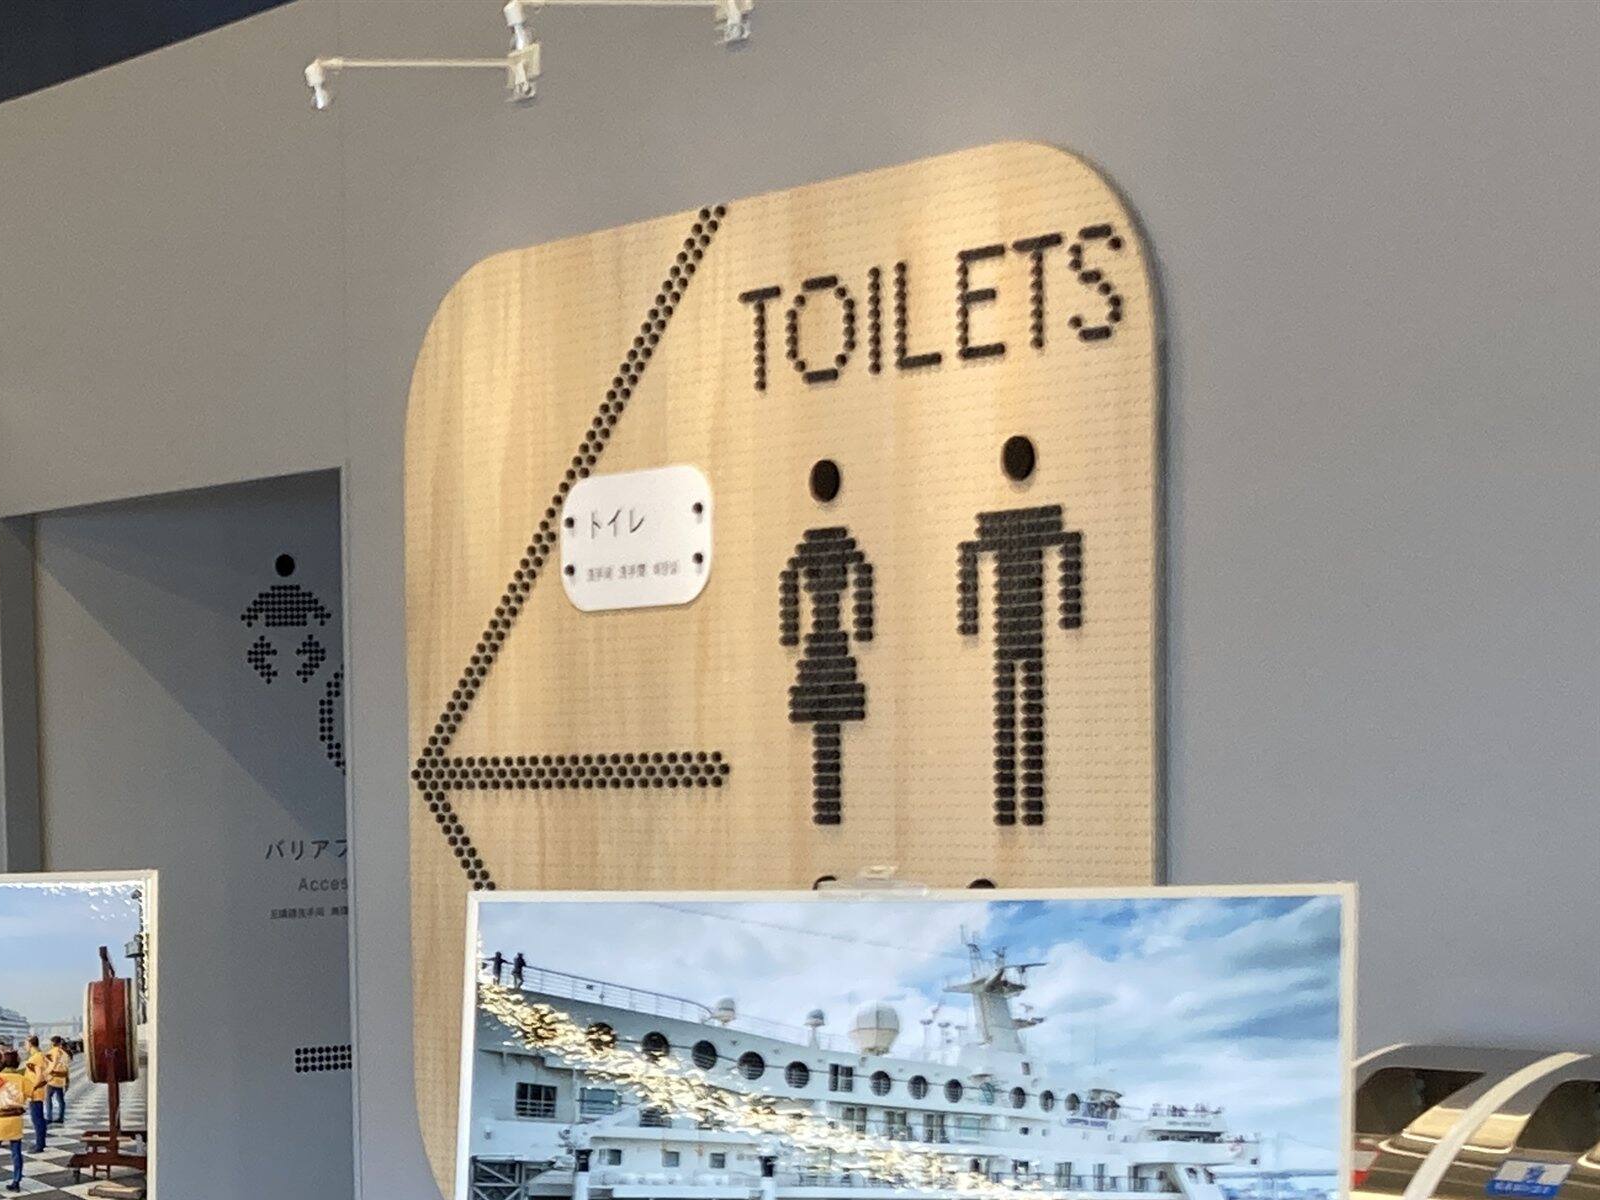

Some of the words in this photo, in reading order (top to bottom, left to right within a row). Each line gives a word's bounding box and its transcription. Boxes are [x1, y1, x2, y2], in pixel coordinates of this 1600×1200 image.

[738, 222, 1123, 391] TOILETS
[590, 508, 646, 540] トイレ
